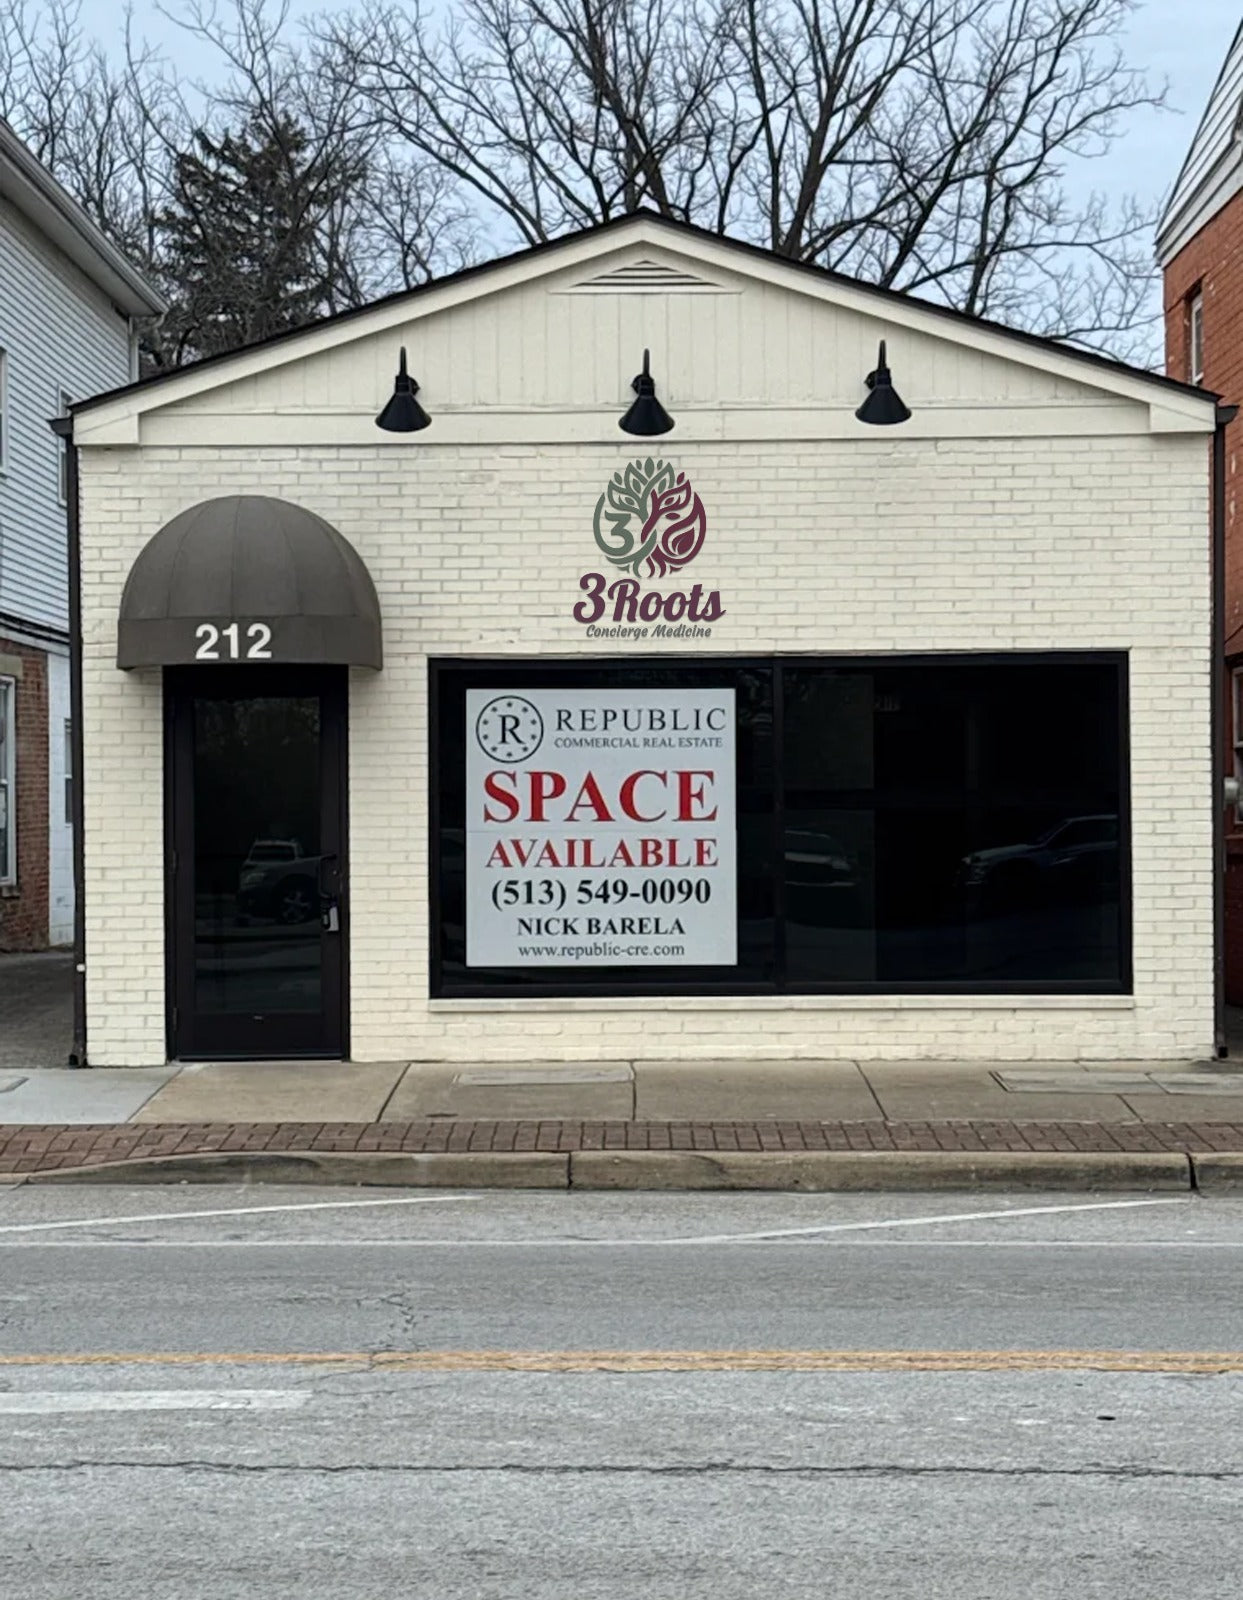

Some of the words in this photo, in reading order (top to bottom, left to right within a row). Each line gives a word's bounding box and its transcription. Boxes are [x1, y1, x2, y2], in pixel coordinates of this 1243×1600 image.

[195, 623, 272, 659] 212
[586, 625, 648, 641] Concierge
[651, 624, 711, 637] Medicine
[498, 714, 525, 745] R
[555, 708, 726, 731] REPUBLIC
[554, 737, 640, 748] COMMERCIAL
[643, 737, 676, 748] REAL
[678, 737, 723, 748] ESTATE
[484, 770, 718, 823] SPACE
[485, 839, 719, 868] AVAILABLE
[491, 879, 567, 911] (513)
[577, 878, 711, 905] 549-0090
[517, 917, 580, 936] NICK
[587, 917, 686, 935] BARELA
[518, 942, 685, 959] www.republic-cre.com
